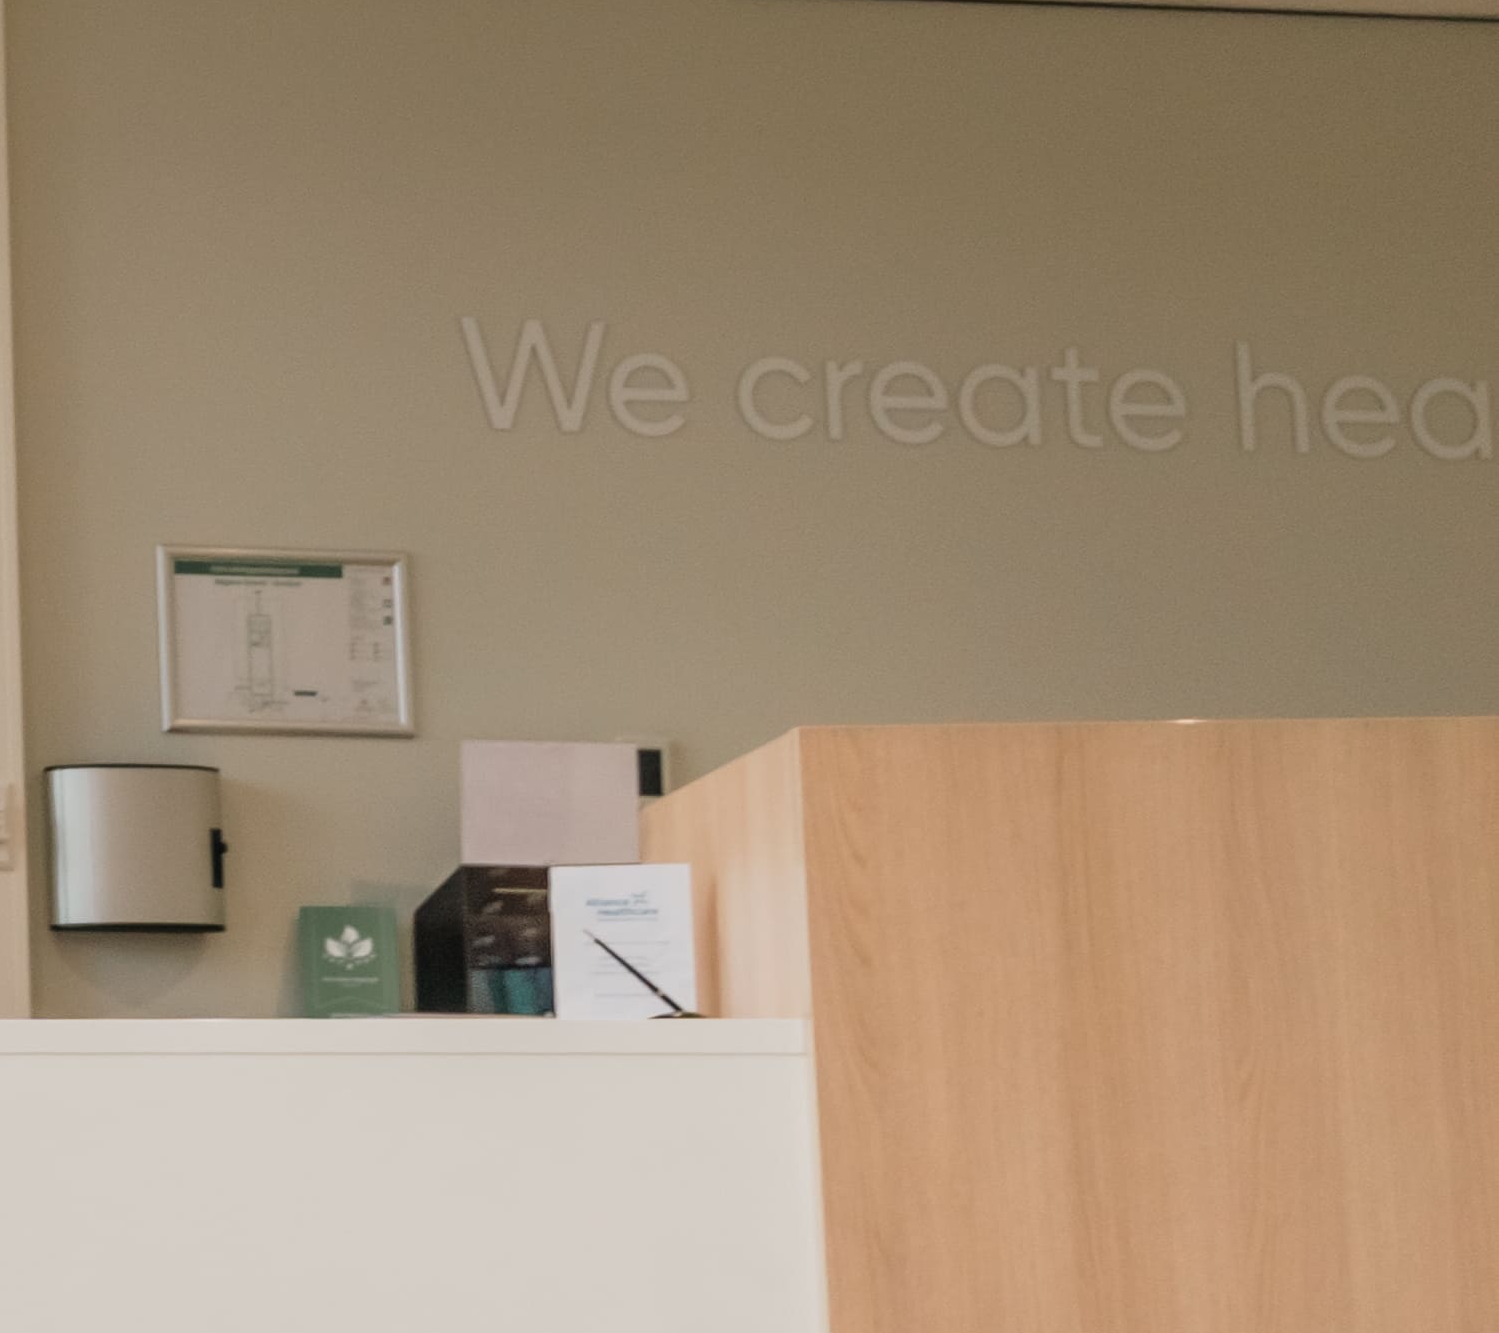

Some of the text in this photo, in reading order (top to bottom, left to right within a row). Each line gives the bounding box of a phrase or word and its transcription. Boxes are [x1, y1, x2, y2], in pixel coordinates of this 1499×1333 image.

[461, 317, 1493, 460] We create hea
